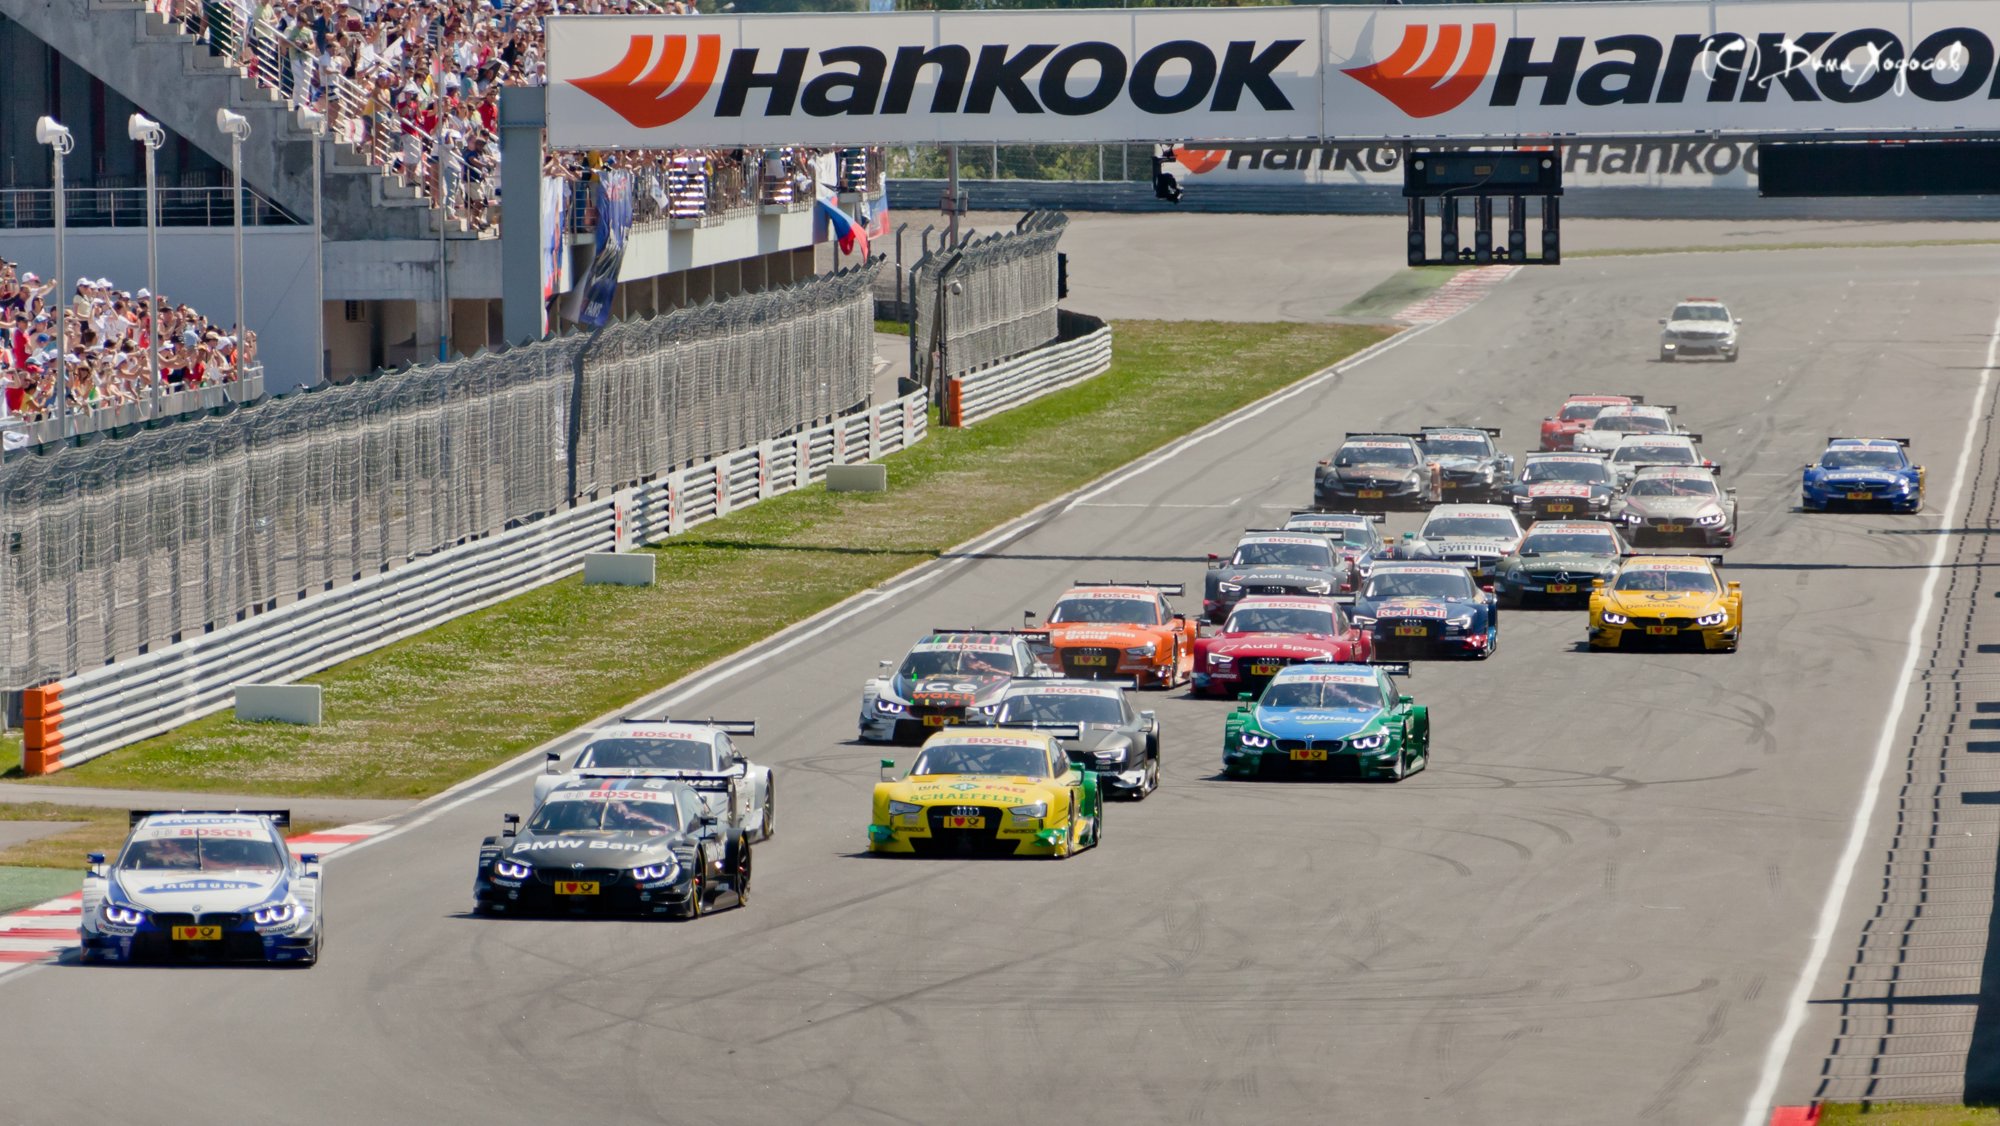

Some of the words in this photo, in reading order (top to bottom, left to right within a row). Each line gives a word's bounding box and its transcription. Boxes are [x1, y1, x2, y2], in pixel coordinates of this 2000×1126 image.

[1488, 26, 2000, 106] HanKOO
[1377, 607, 1410, 618] Red
[1413, 607, 1447, 618] Bull
[946, 643, 1000, 652] BOSCH
[1308, 674, 1366, 683] BOSCH
[911, 691, 976, 701] watch
[631, 731, 693, 740] BOSCH
[967, 737, 1029, 746] BOSCH
[589, 790, 658, 800] BOSCH
[909, 792, 1025, 805] SCHAEFFLER
[179, 828, 253, 838] BOSCH
[512, 840, 585, 854] BMW
[588, 840, 655, 855] Bank
[153, 879, 251, 890] SAMSUNG
